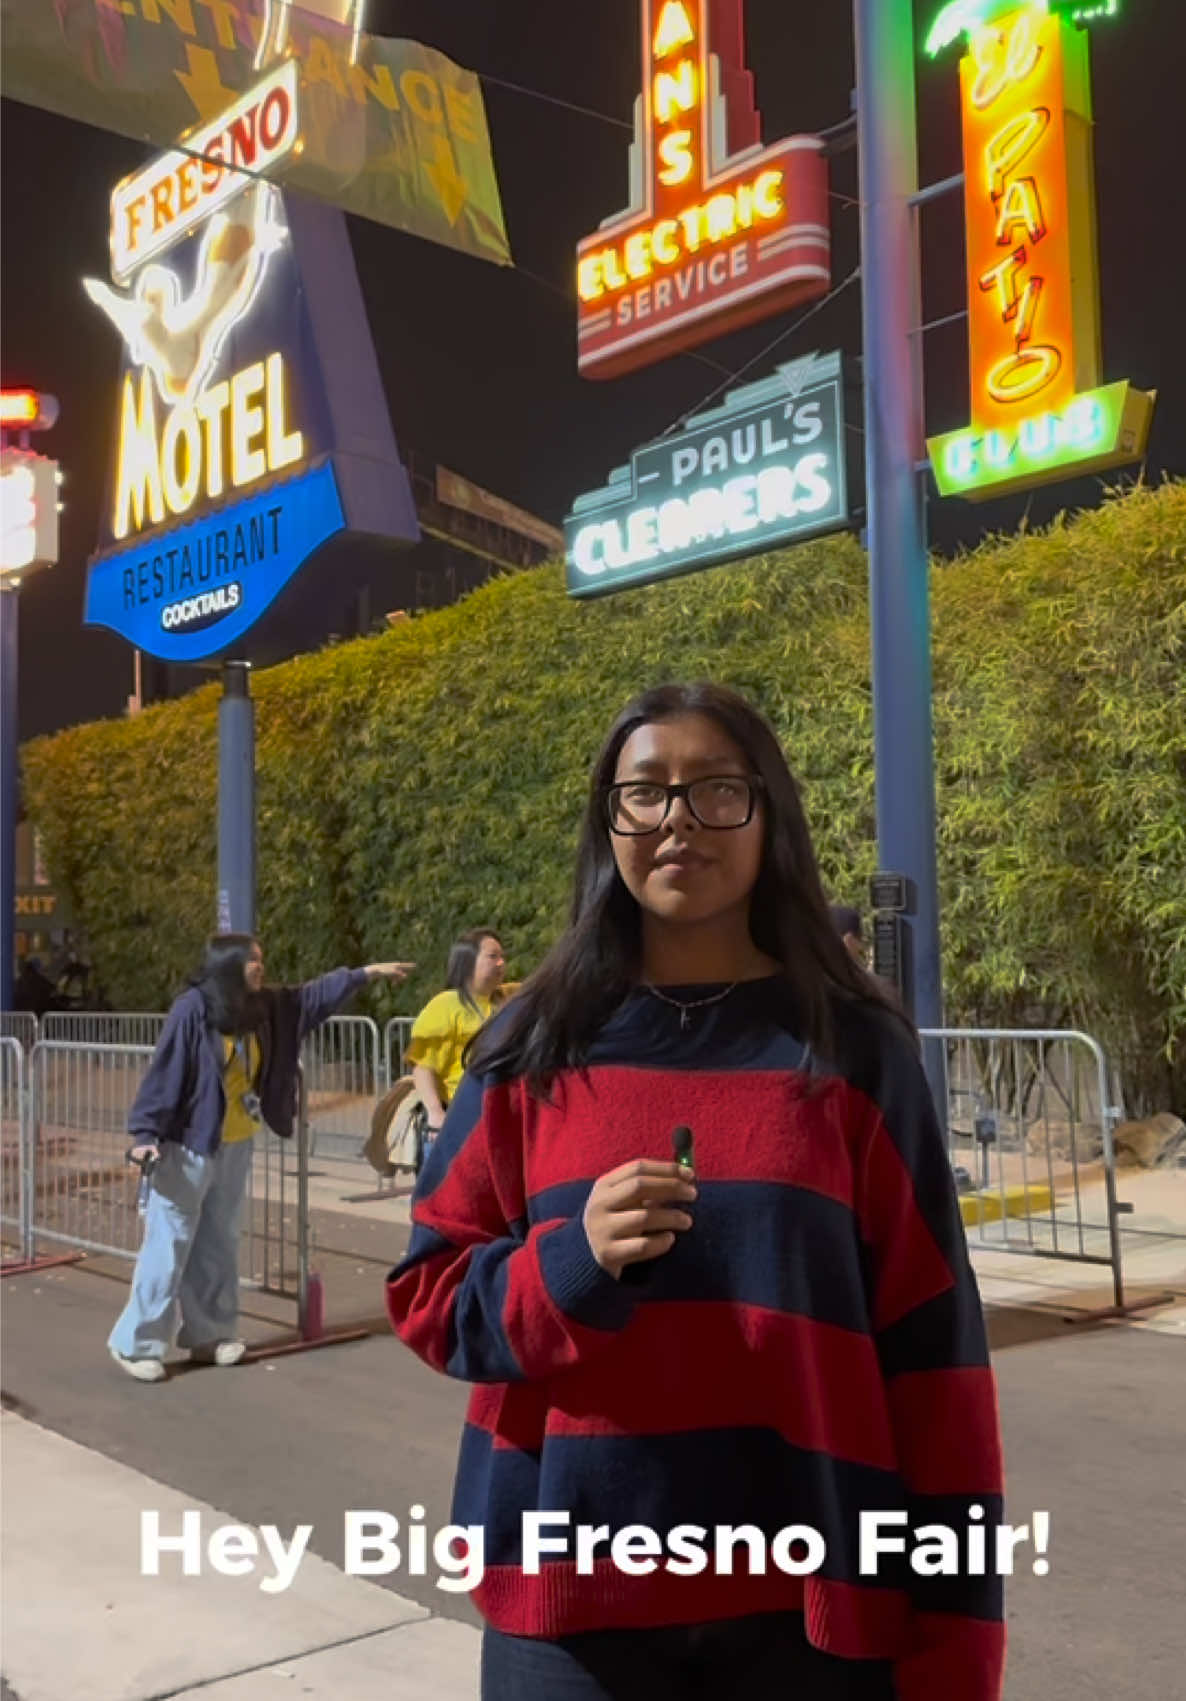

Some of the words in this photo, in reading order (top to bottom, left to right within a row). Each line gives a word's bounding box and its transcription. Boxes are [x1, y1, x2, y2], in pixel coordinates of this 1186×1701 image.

[115, 0, 479, 143] NTANCE
[123, 86, 291, 252] FRESNO
[577, 169, 784, 301] ELECTRIC
[616, 242, 749, 326] SERVICE
[978, 106, 1062, 403] PATIO
[112, 351, 304, 540] MOTEL
[671, 401, 823, 486] PAUL'S
[943, 396, 1107, 480] CLUB
[122, 505, 284, 611] RESTAURANT
[161, 584, 240, 630] COCKTAILS
[15, 895, 57, 915] XIT
